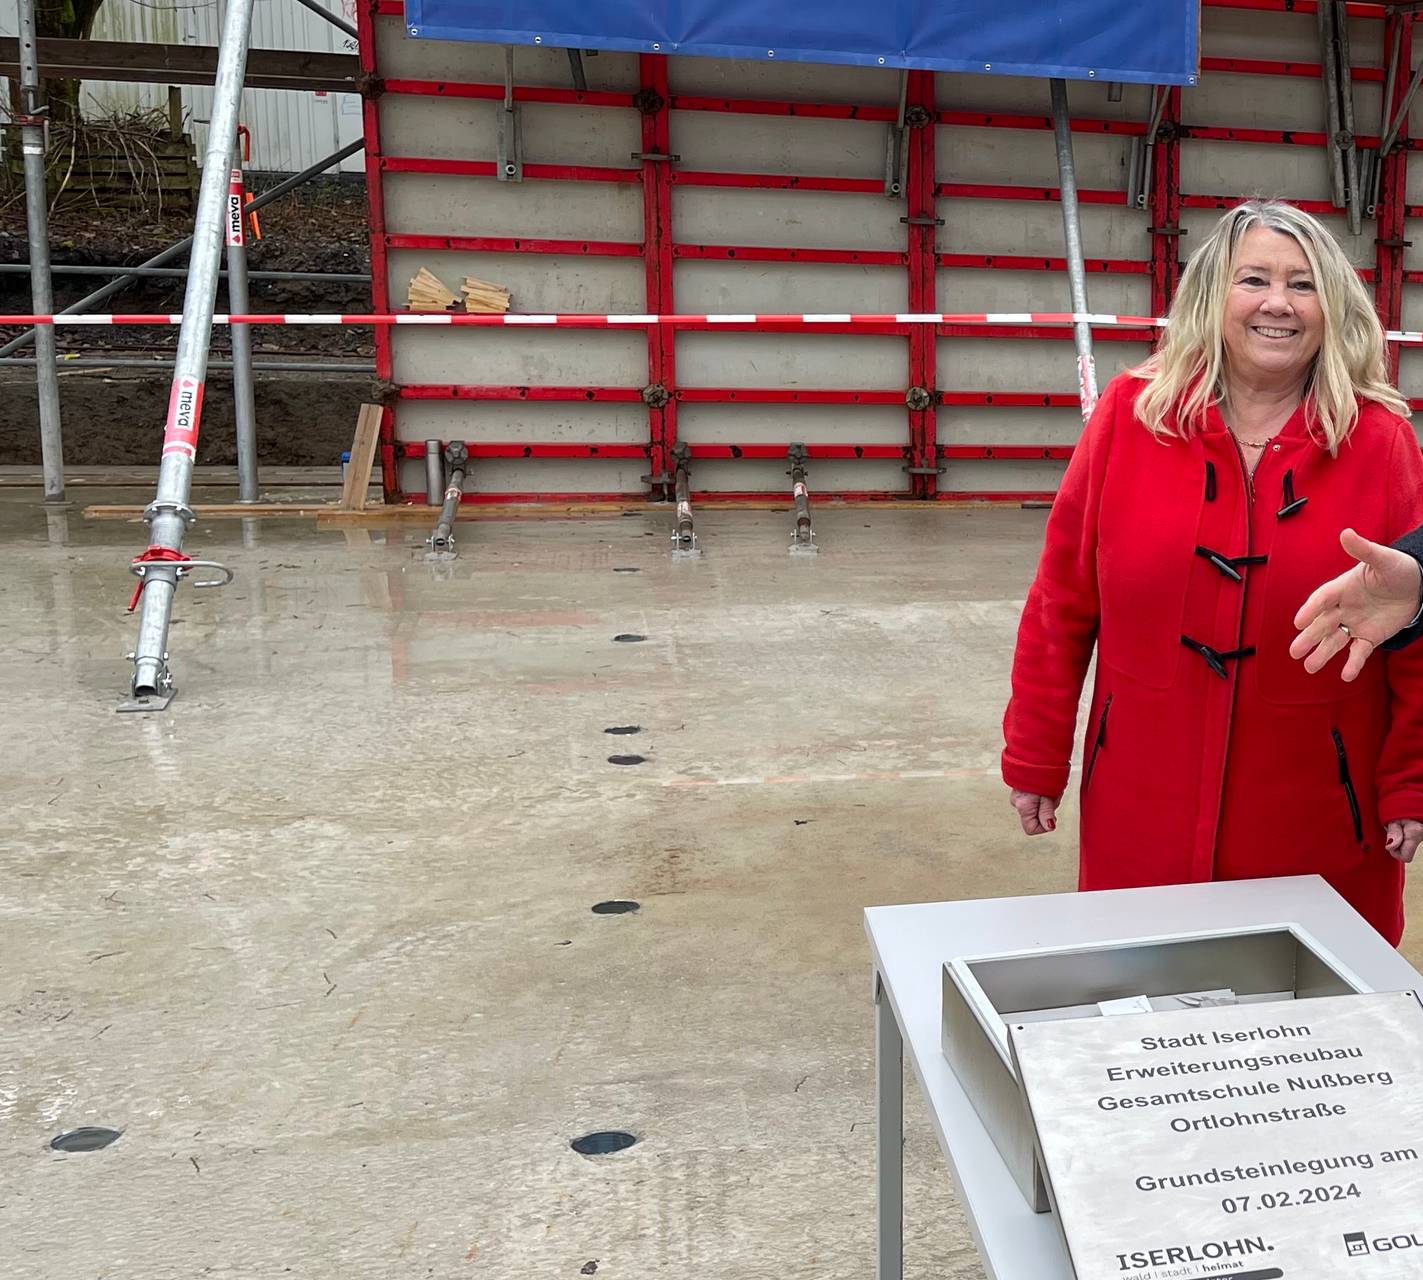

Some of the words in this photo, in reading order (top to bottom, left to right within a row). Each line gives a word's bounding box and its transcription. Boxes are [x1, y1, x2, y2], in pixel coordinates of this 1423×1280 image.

[231, 196, 240, 232] meva
[177, 391, 193, 428] meva
[1141, 1033, 1207, 1051] Stadt
[1212, 1024, 1312, 1044] Iserlohn
[1106, 1046, 1363, 1081] Erweiterungsneubau
[1097, 1081, 1280, 1111] Gesamtschule
[1286, 1070, 1393, 1092] Nußberg
[1170, 1103, 1347, 1132] Ortlohnstraße
[1135, 1152, 1374, 1191] Grundsteinlegung
[1380, 1148, 1419, 1163] am
[1221, 1183, 1361, 1214] 07.02.2024
[1116, 1236, 1275, 1270] ISERLOHN.
[1161, 1267, 1192, 1278] stadt
[1202, 1260, 1244, 1273] heimat
